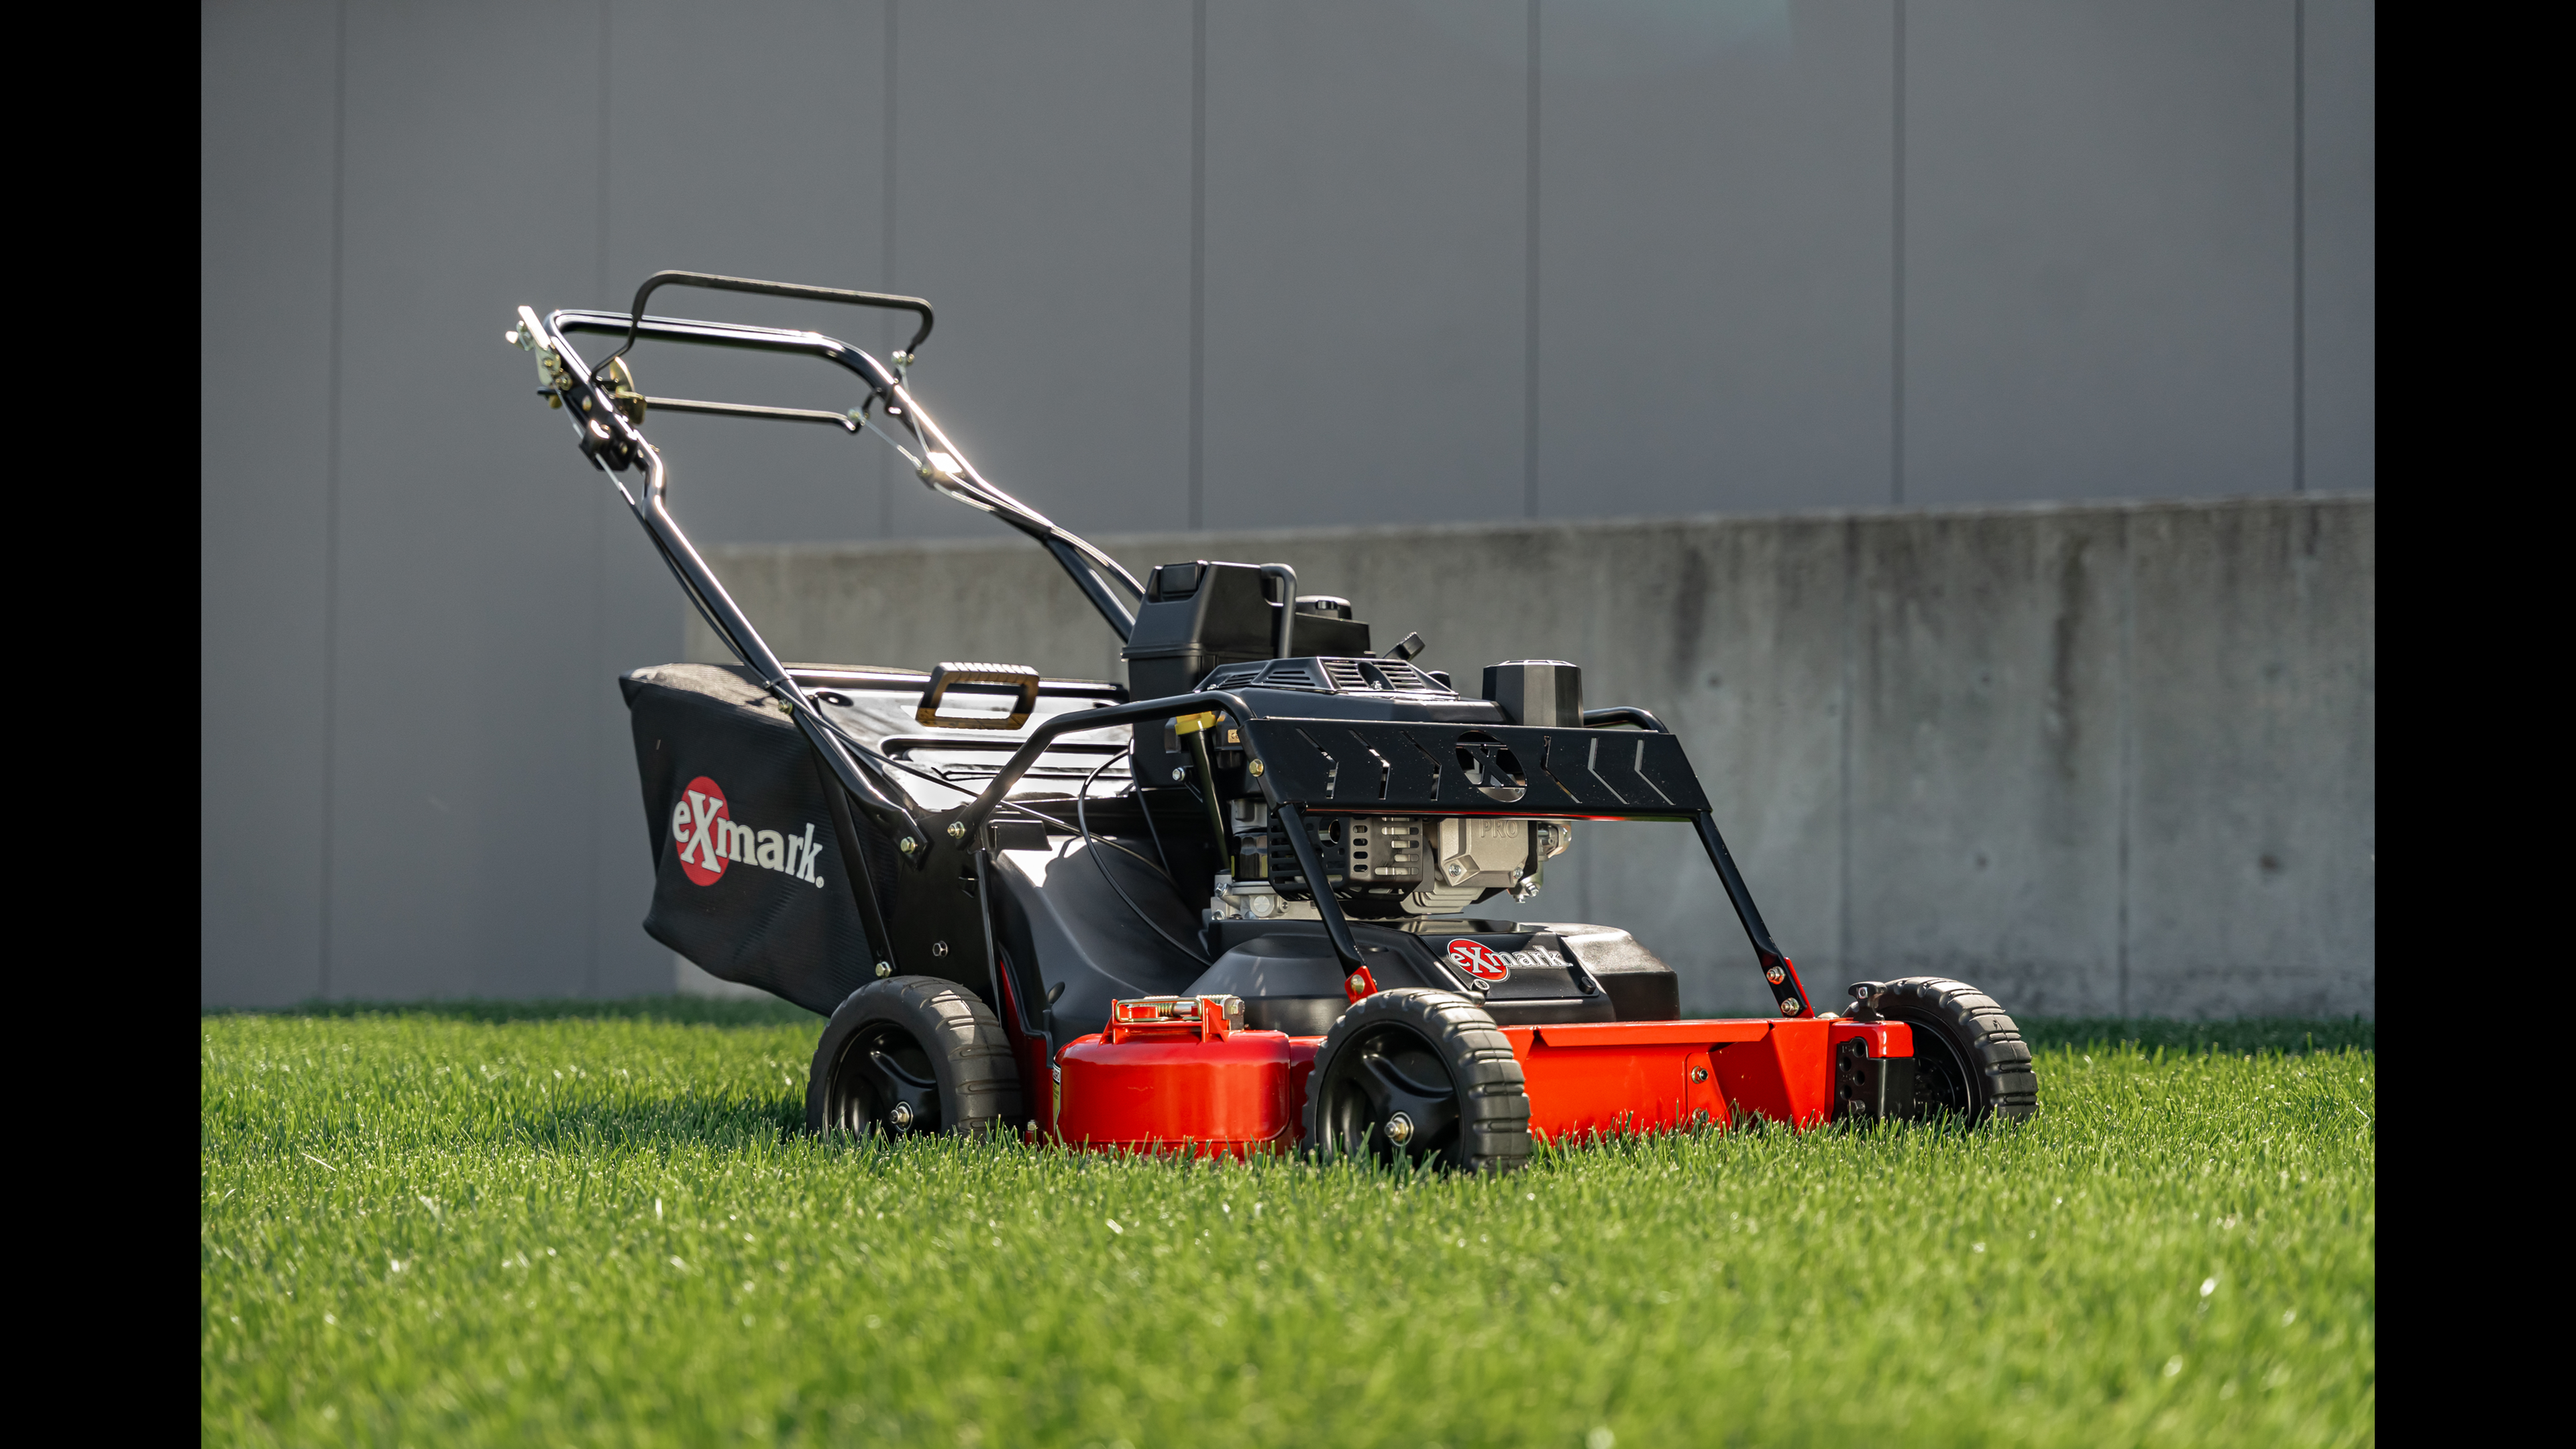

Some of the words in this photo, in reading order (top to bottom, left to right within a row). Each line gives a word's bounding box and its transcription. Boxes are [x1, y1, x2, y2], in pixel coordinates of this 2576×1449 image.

[672, 790, 824, 885] eXmark
[1480, 819, 1519, 839] PRO
[1450, 945, 1570, 973] eXmark
